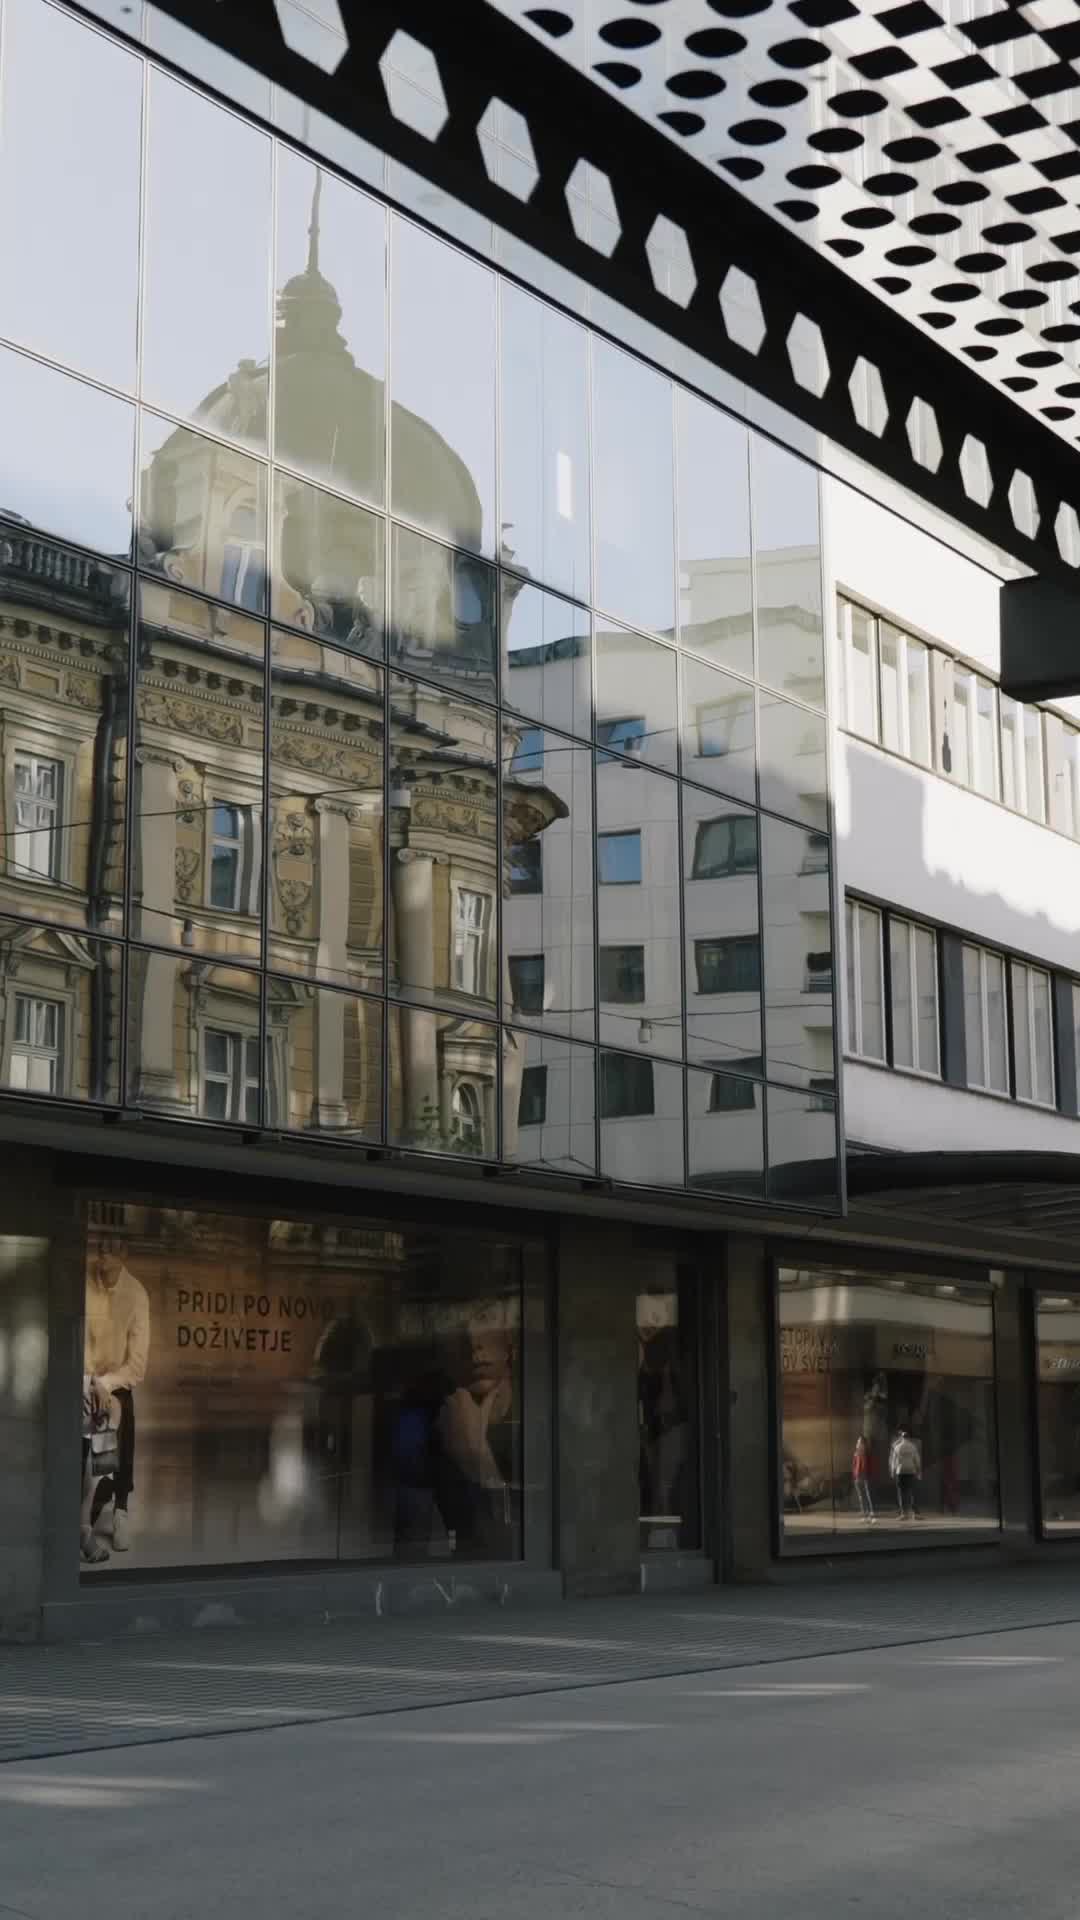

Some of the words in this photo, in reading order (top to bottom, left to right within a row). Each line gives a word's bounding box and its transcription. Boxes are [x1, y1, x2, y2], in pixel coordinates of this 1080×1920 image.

[178, 1290, 235, 1315] PRIDI
[244, 1296, 270, 1317] PO
[279, 1299, 334, 1320] NOVO
[177, 1322, 292, 1352] DOŽIVETJE
